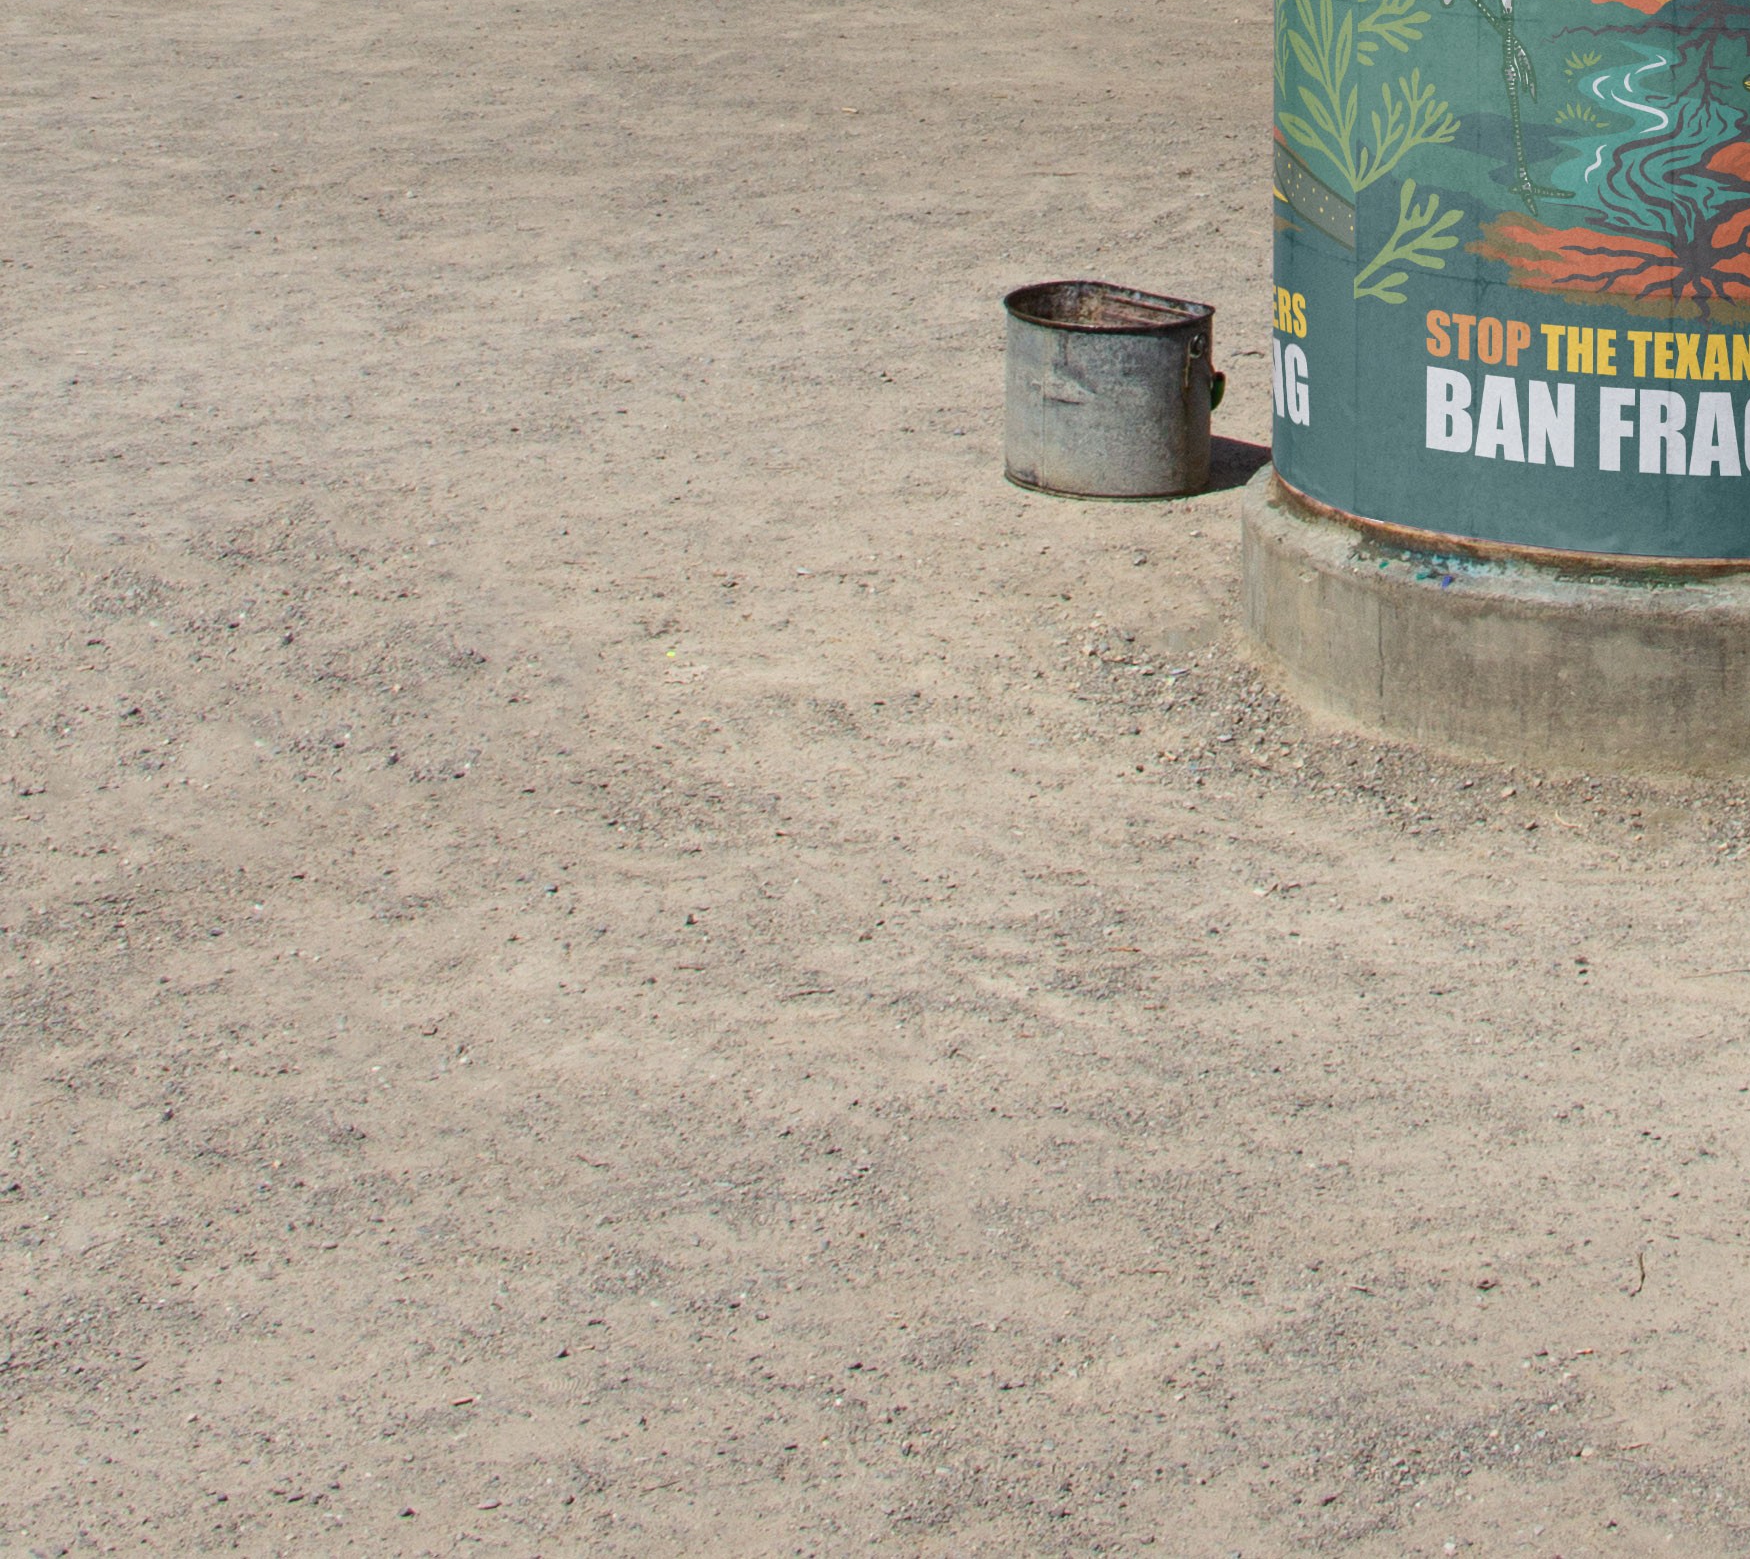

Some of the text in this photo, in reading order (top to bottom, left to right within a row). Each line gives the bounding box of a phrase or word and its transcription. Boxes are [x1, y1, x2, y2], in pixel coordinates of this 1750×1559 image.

[1426, 309, 1531, 366] STOP
[1541, 324, 1617, 376] THE
[1425, 365, 1576, 469] BAN
